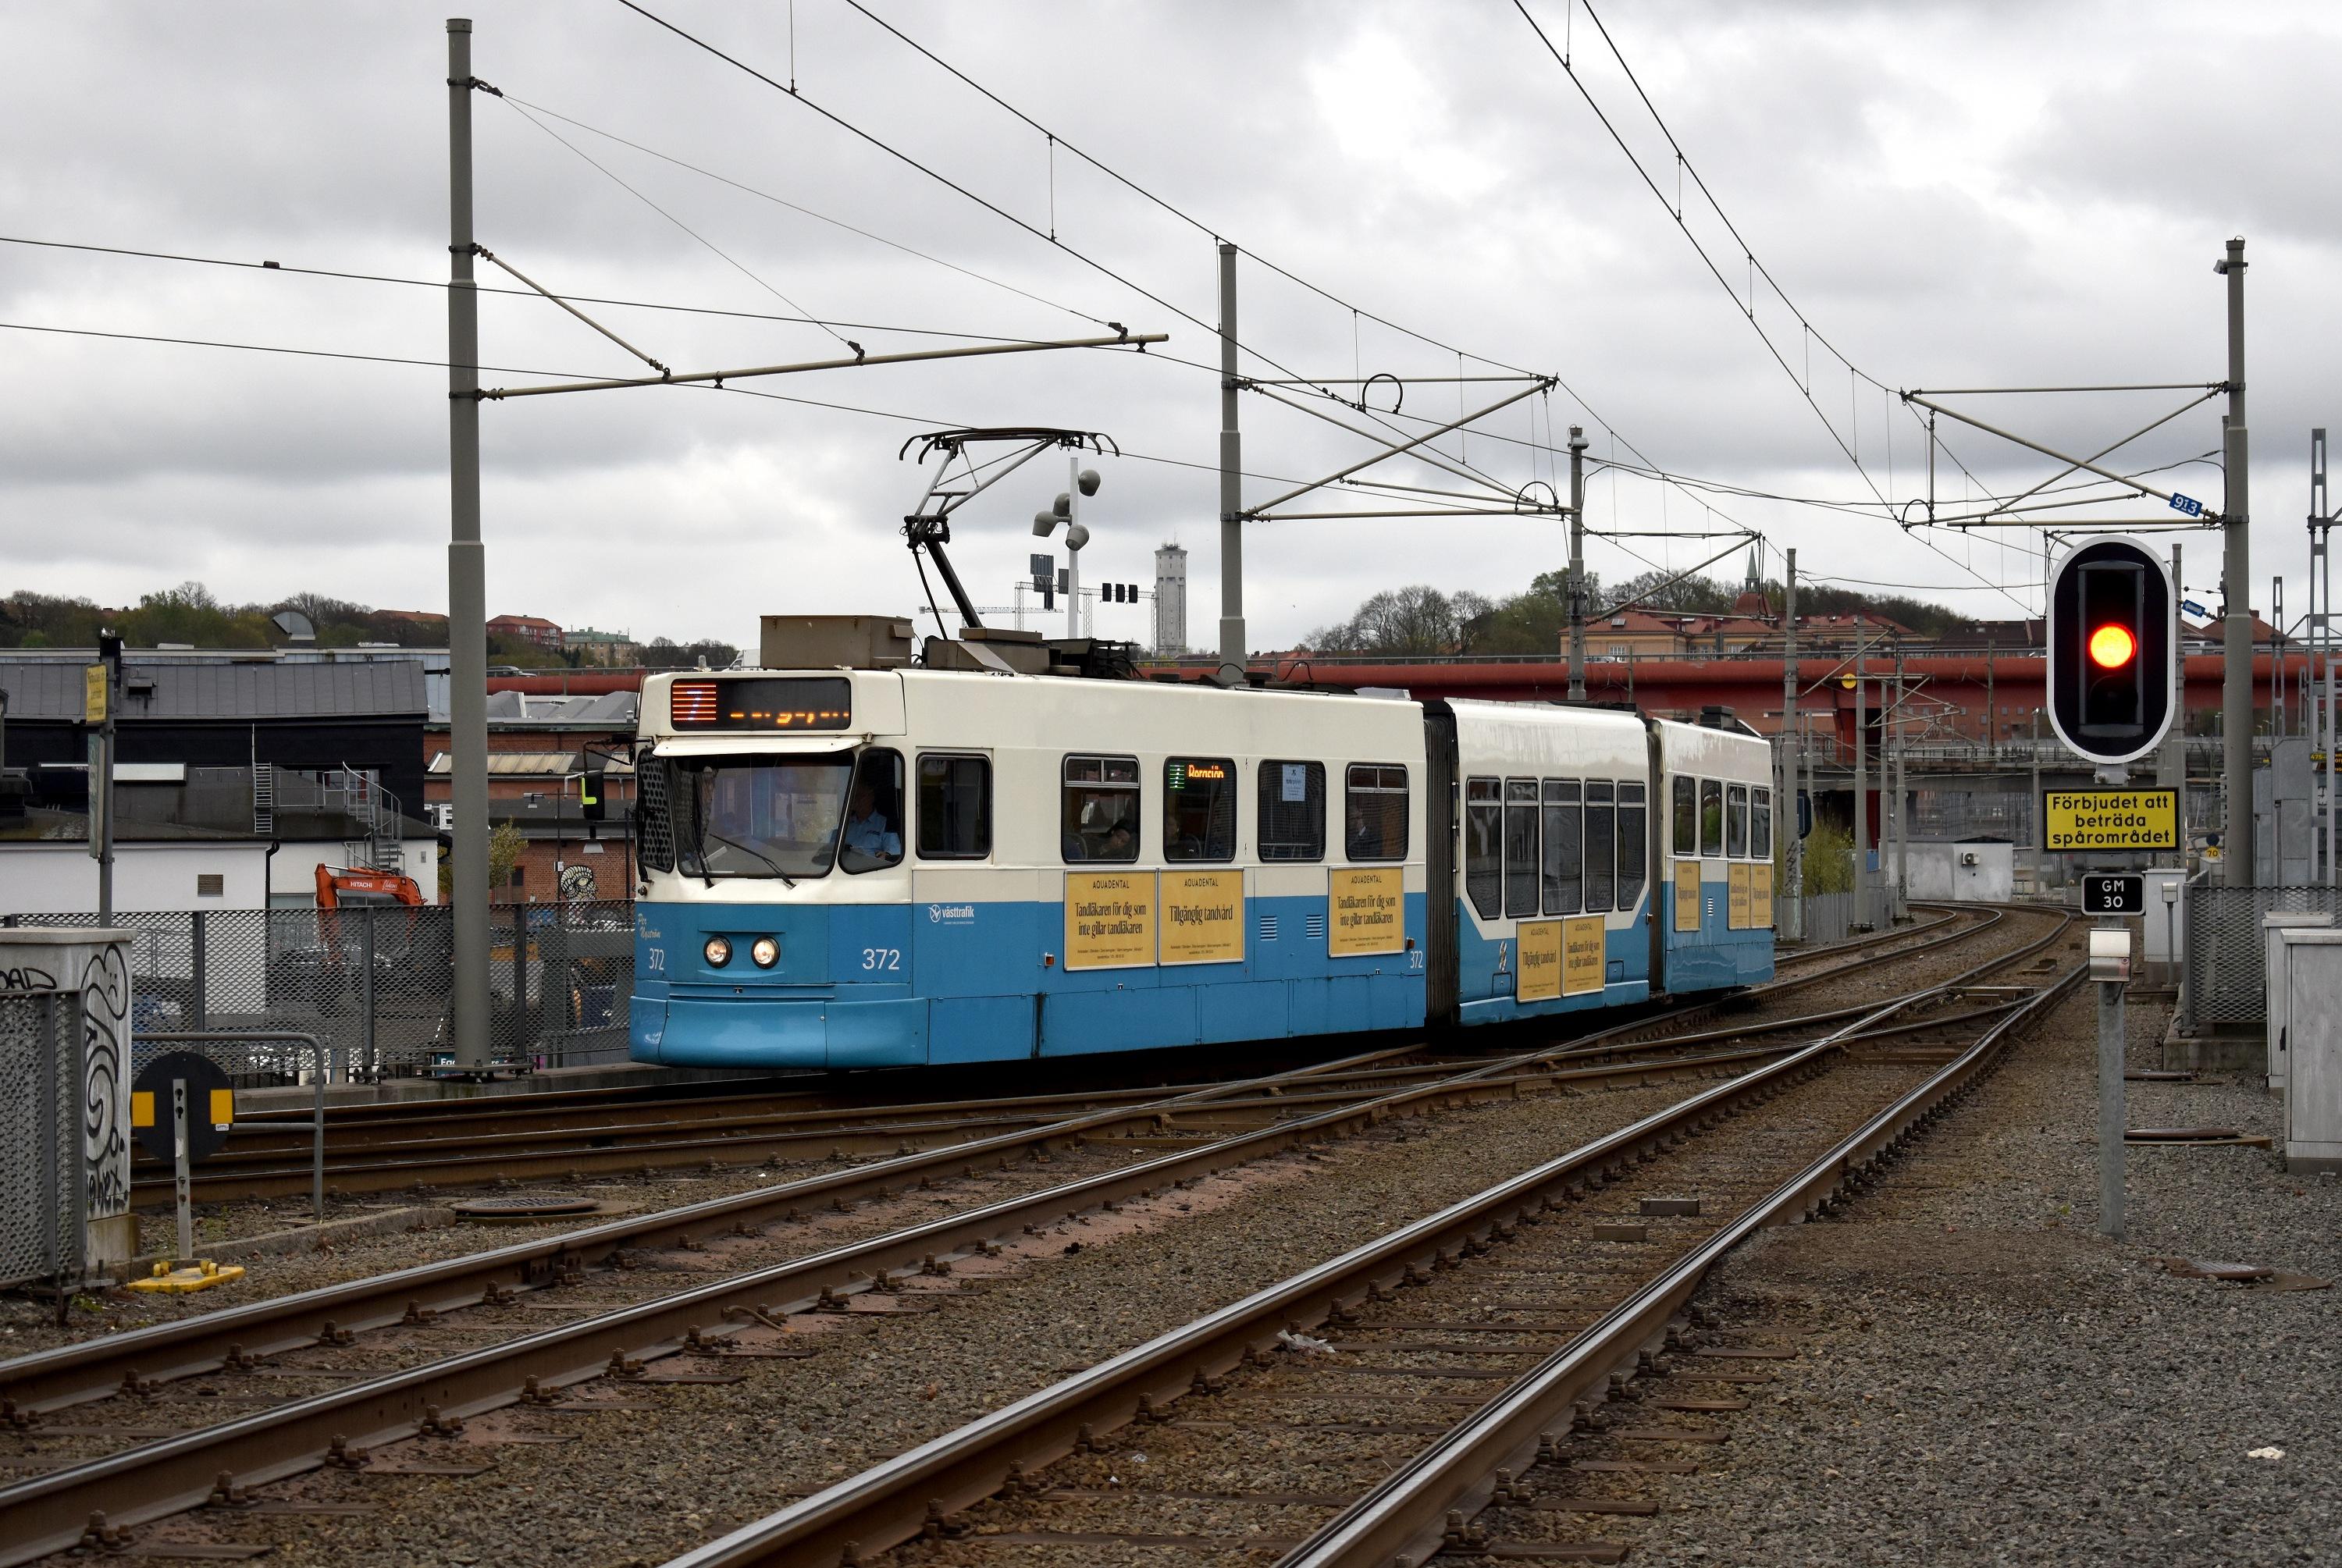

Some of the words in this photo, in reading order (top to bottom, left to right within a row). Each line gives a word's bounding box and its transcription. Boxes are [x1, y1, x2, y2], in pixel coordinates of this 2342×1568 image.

[2174, 496, 2197, 514] 913
[2052, 795, 2137, 812] Förbjudet
[2145, 795, 2168, 809] att
[2075, 813, 2146, 828] beträda
[2052, 830, 2169, 847] spårområdet
[2102, 880, 2124, 892] GM
[1075, 902, 1112, 917] Tandläkaren
[1112, 901, 1122, 916] för
[1123, 901, 1133, 919] dig
[1134, 905, 1146, 916] som
[1337, 896, 1366, 908] Tandläkaren
[1376, 894, 1385, 909] dig
[1386, 897, 1396, 906] som
[2103, 895, 2123, 908] 30
[942, 905, 974, 918] västtrafik
[1169, 905, 1203, 926] Tillgänglig
[1204, 904, 1233, 921] tandvård
[1340, 913, 1349, 926] inte
[1350, 912, 1363, 929] gillar
[1364, 912, 1393, 924] tandläkaren
[1078, 922, 1091, 936] inte
[1091, 921, 1107, 939] gillar
[1108, 920, 1143, 935] tandläkaren
[649, 948, 664, 971] 372
[862, 948, 900, 970] 372
[1410, 950, 1423, 969] 372
